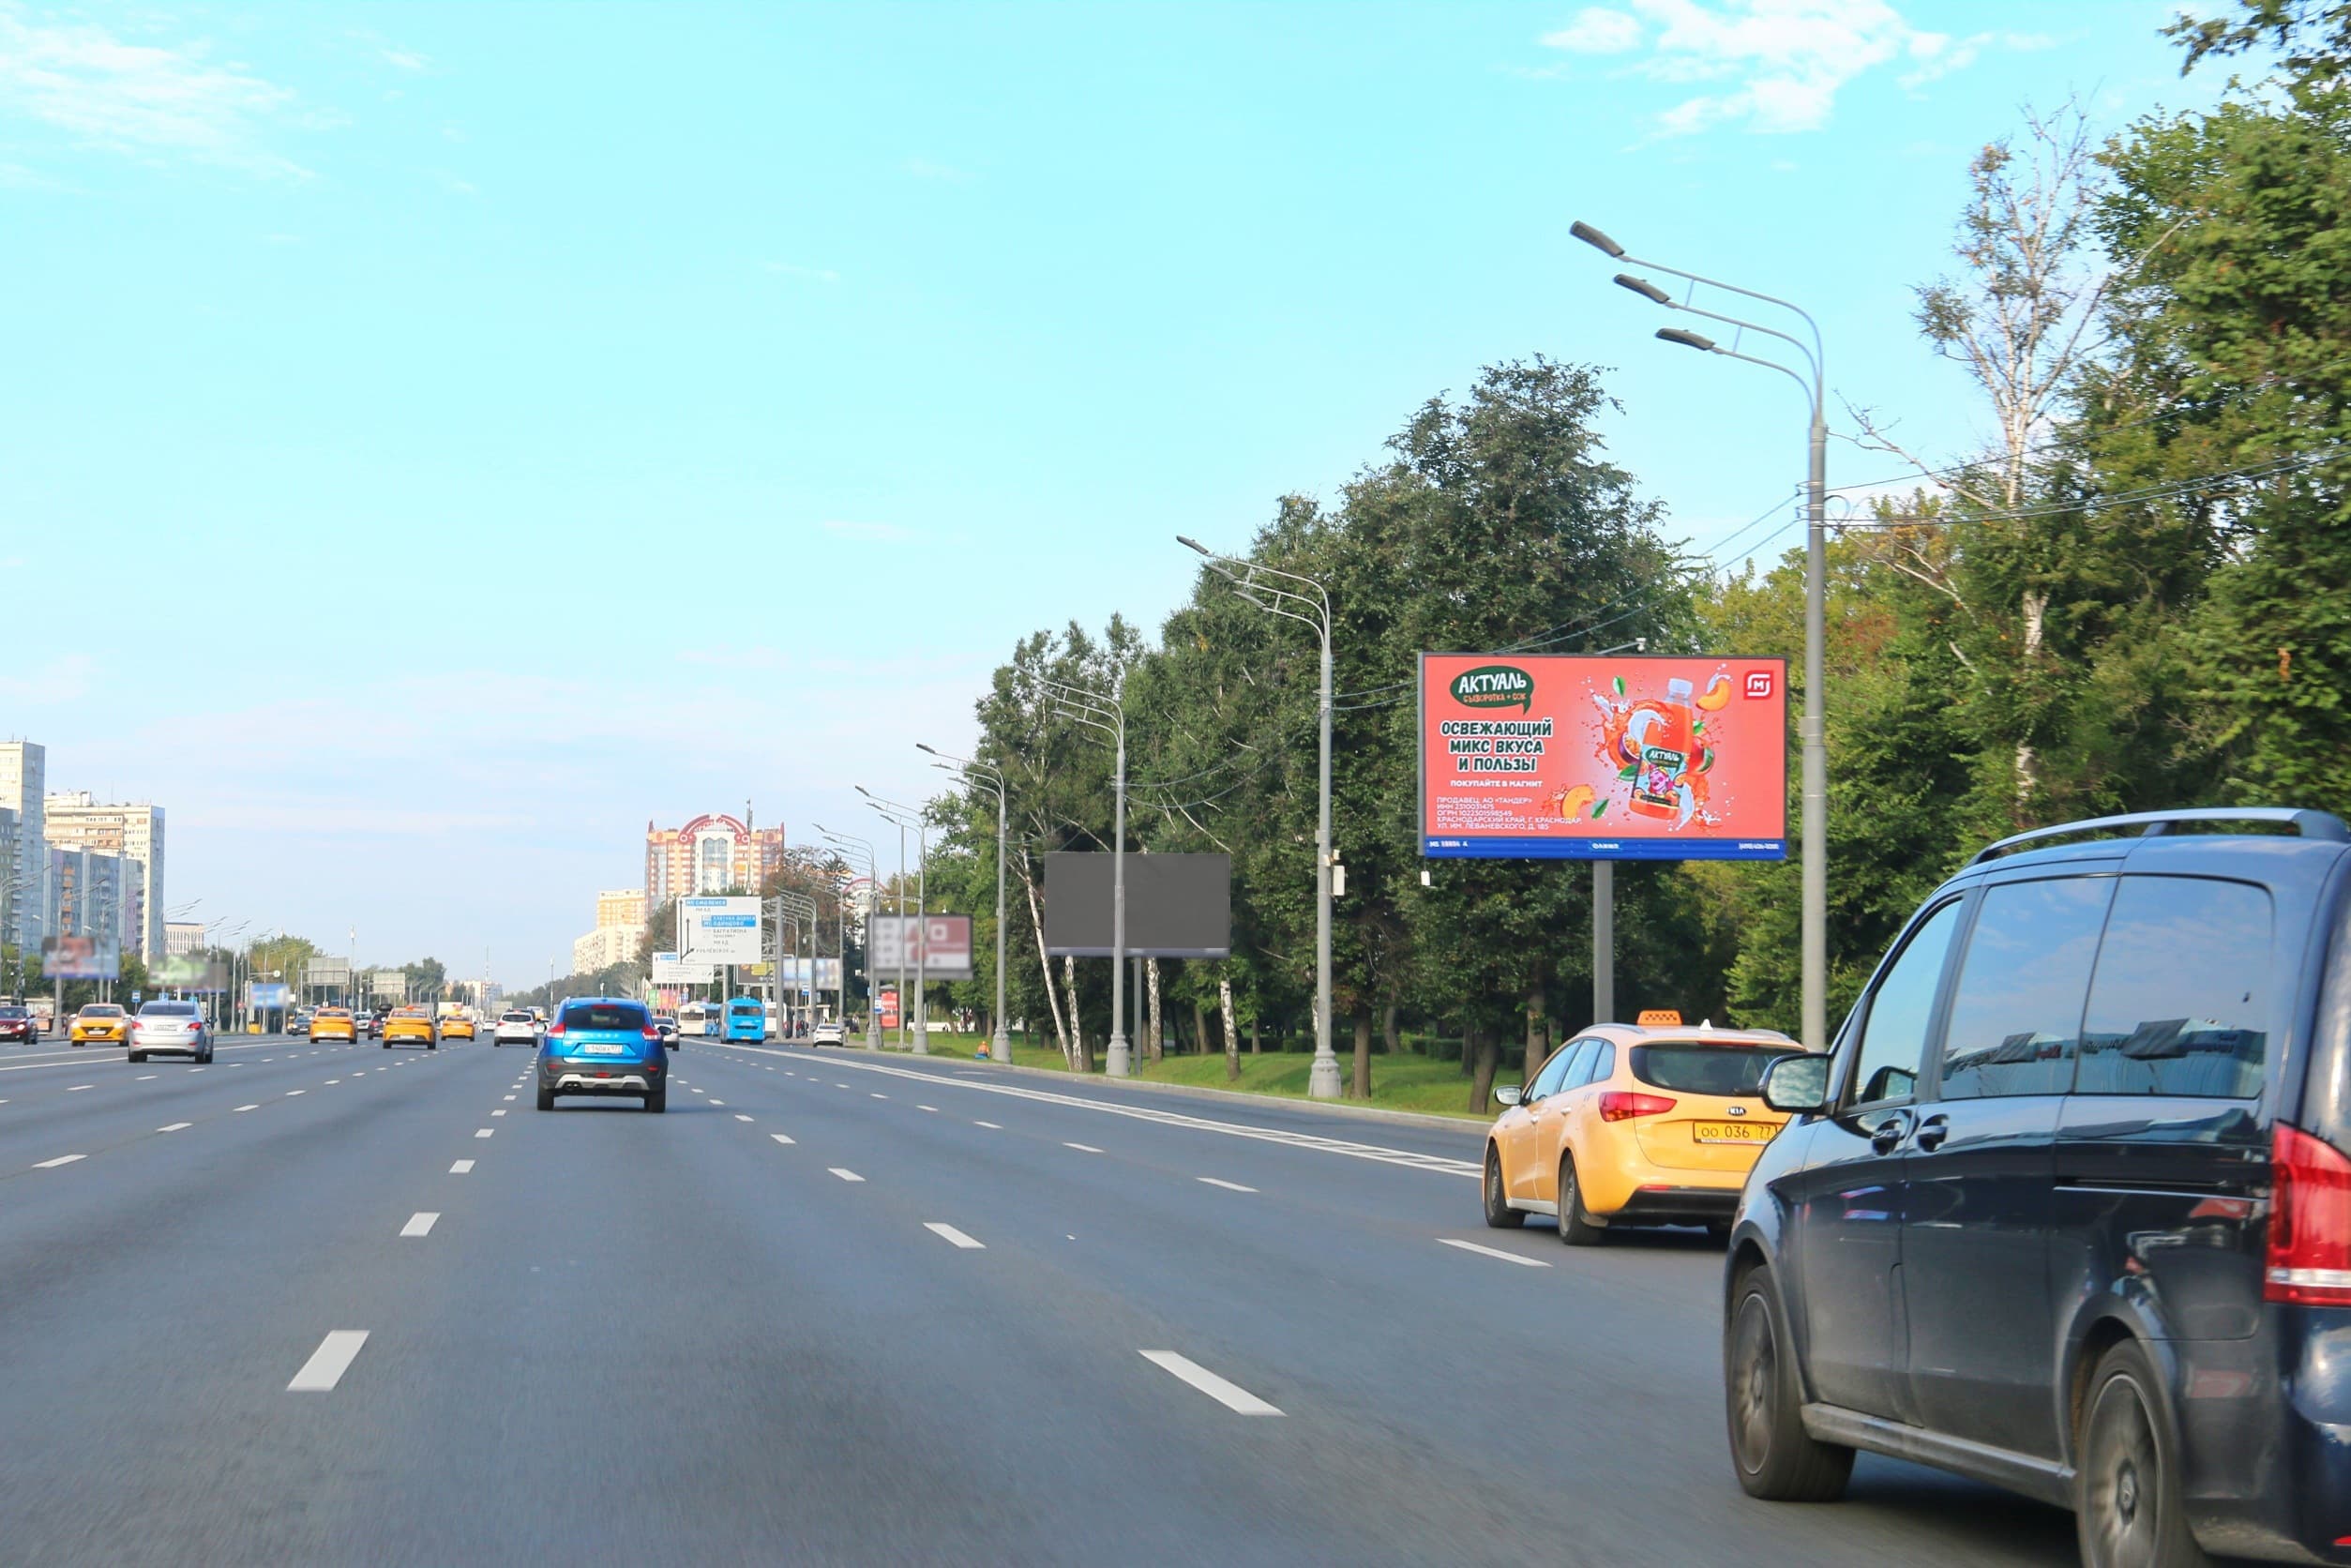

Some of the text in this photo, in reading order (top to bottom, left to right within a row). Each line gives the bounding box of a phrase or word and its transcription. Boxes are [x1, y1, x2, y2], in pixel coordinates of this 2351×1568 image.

[1458, 672, 1527, 694] АКТУАЛЬ
[1463, 693, 1506, 702] СЫВОРОТКА
[1440, 718, 1552, 737] ОСВЕЖАЮЩИЙ
[1450, 740, 1544, 753] МИКС ВКУСА
[1458, 758, 1536, 771] И ПОЛЬЗЫ
[1450, 778, 1500, 788] ПОКУПАЙТЕ
[1728, 1107, 1745, 1116] KIA
[1725, 1125, 1750, 1138] 036
